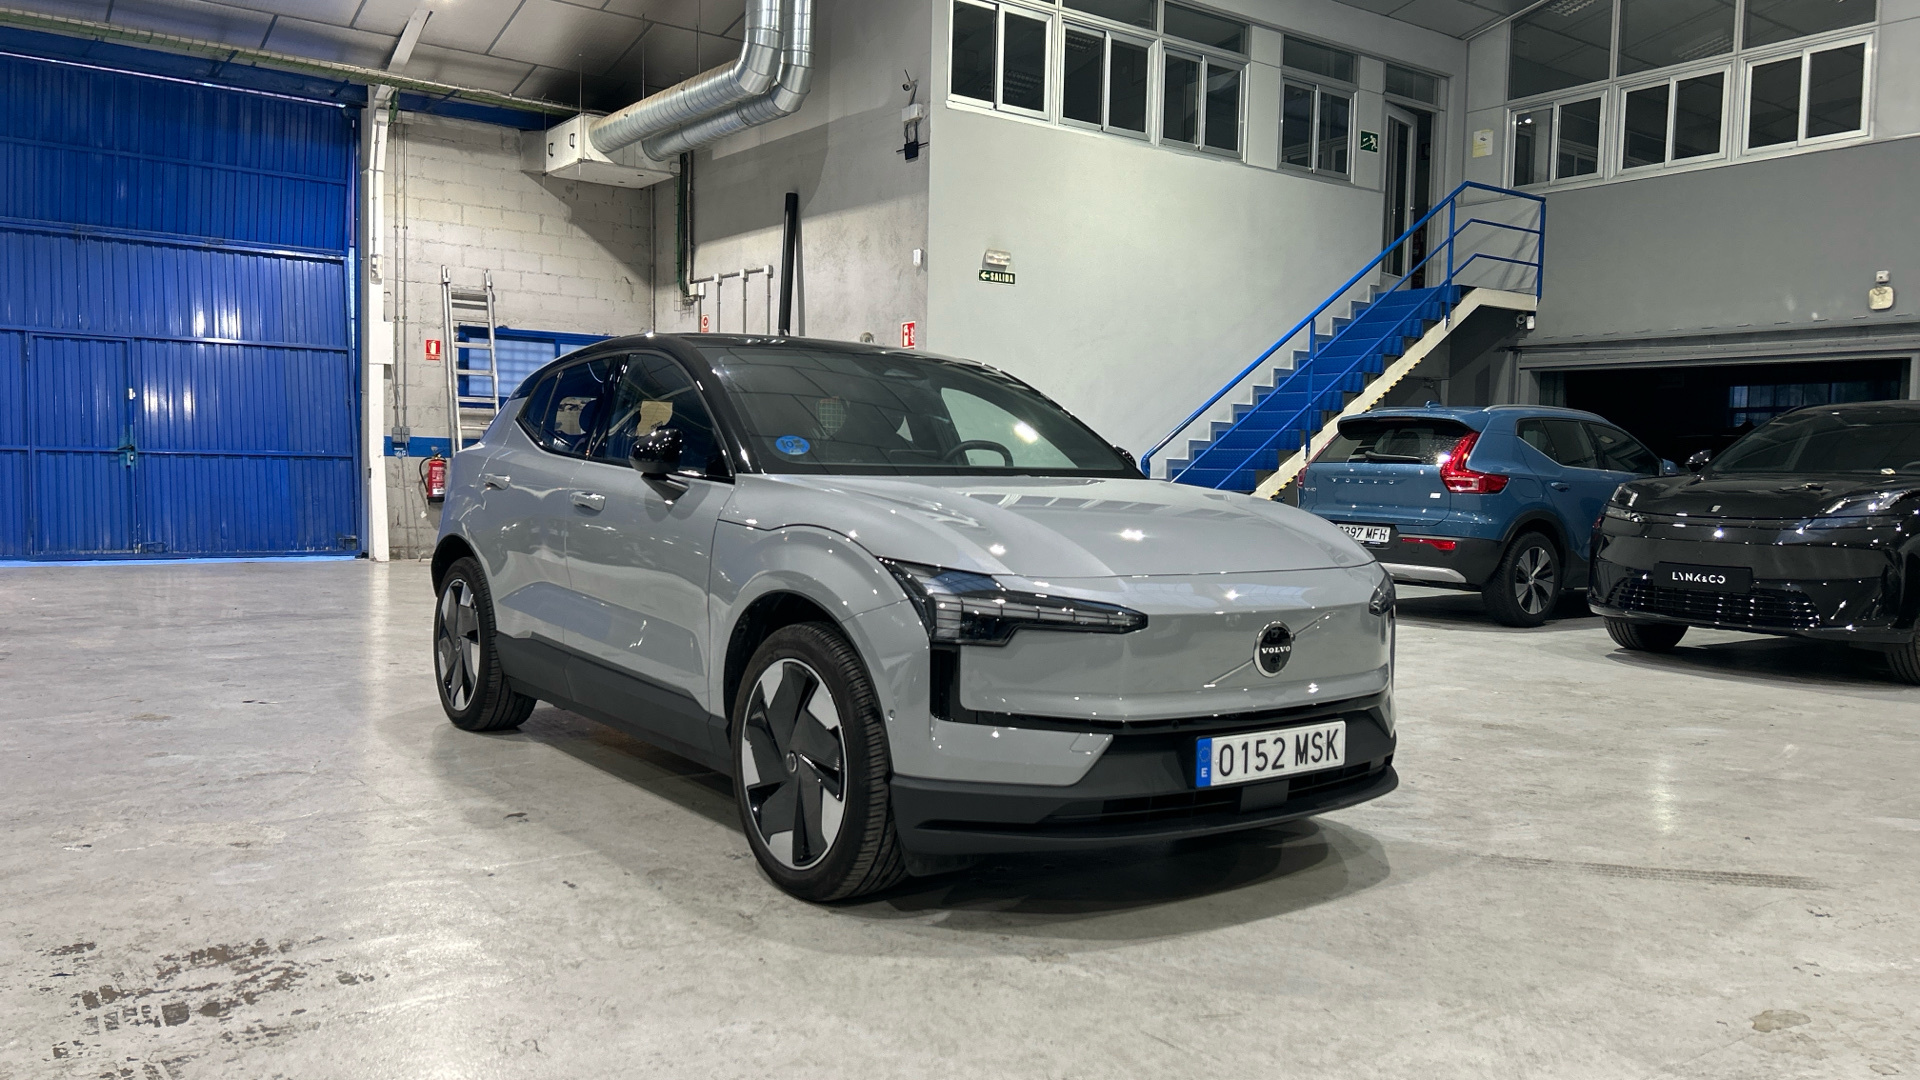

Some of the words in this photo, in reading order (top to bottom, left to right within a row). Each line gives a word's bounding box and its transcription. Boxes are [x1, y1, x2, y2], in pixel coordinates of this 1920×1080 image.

[990, 272, 1013, 283] SALIDA
[1339, 526, 1364, 538] 397
[1366, 527, 1388, 540] MFH
[1261, 645, 1291, 654] VOLVO
[1201, 767, 1208, 778] E
[1218, 737, 1286, 777] 0152
[1294, 728, 1339, 767] MSK
